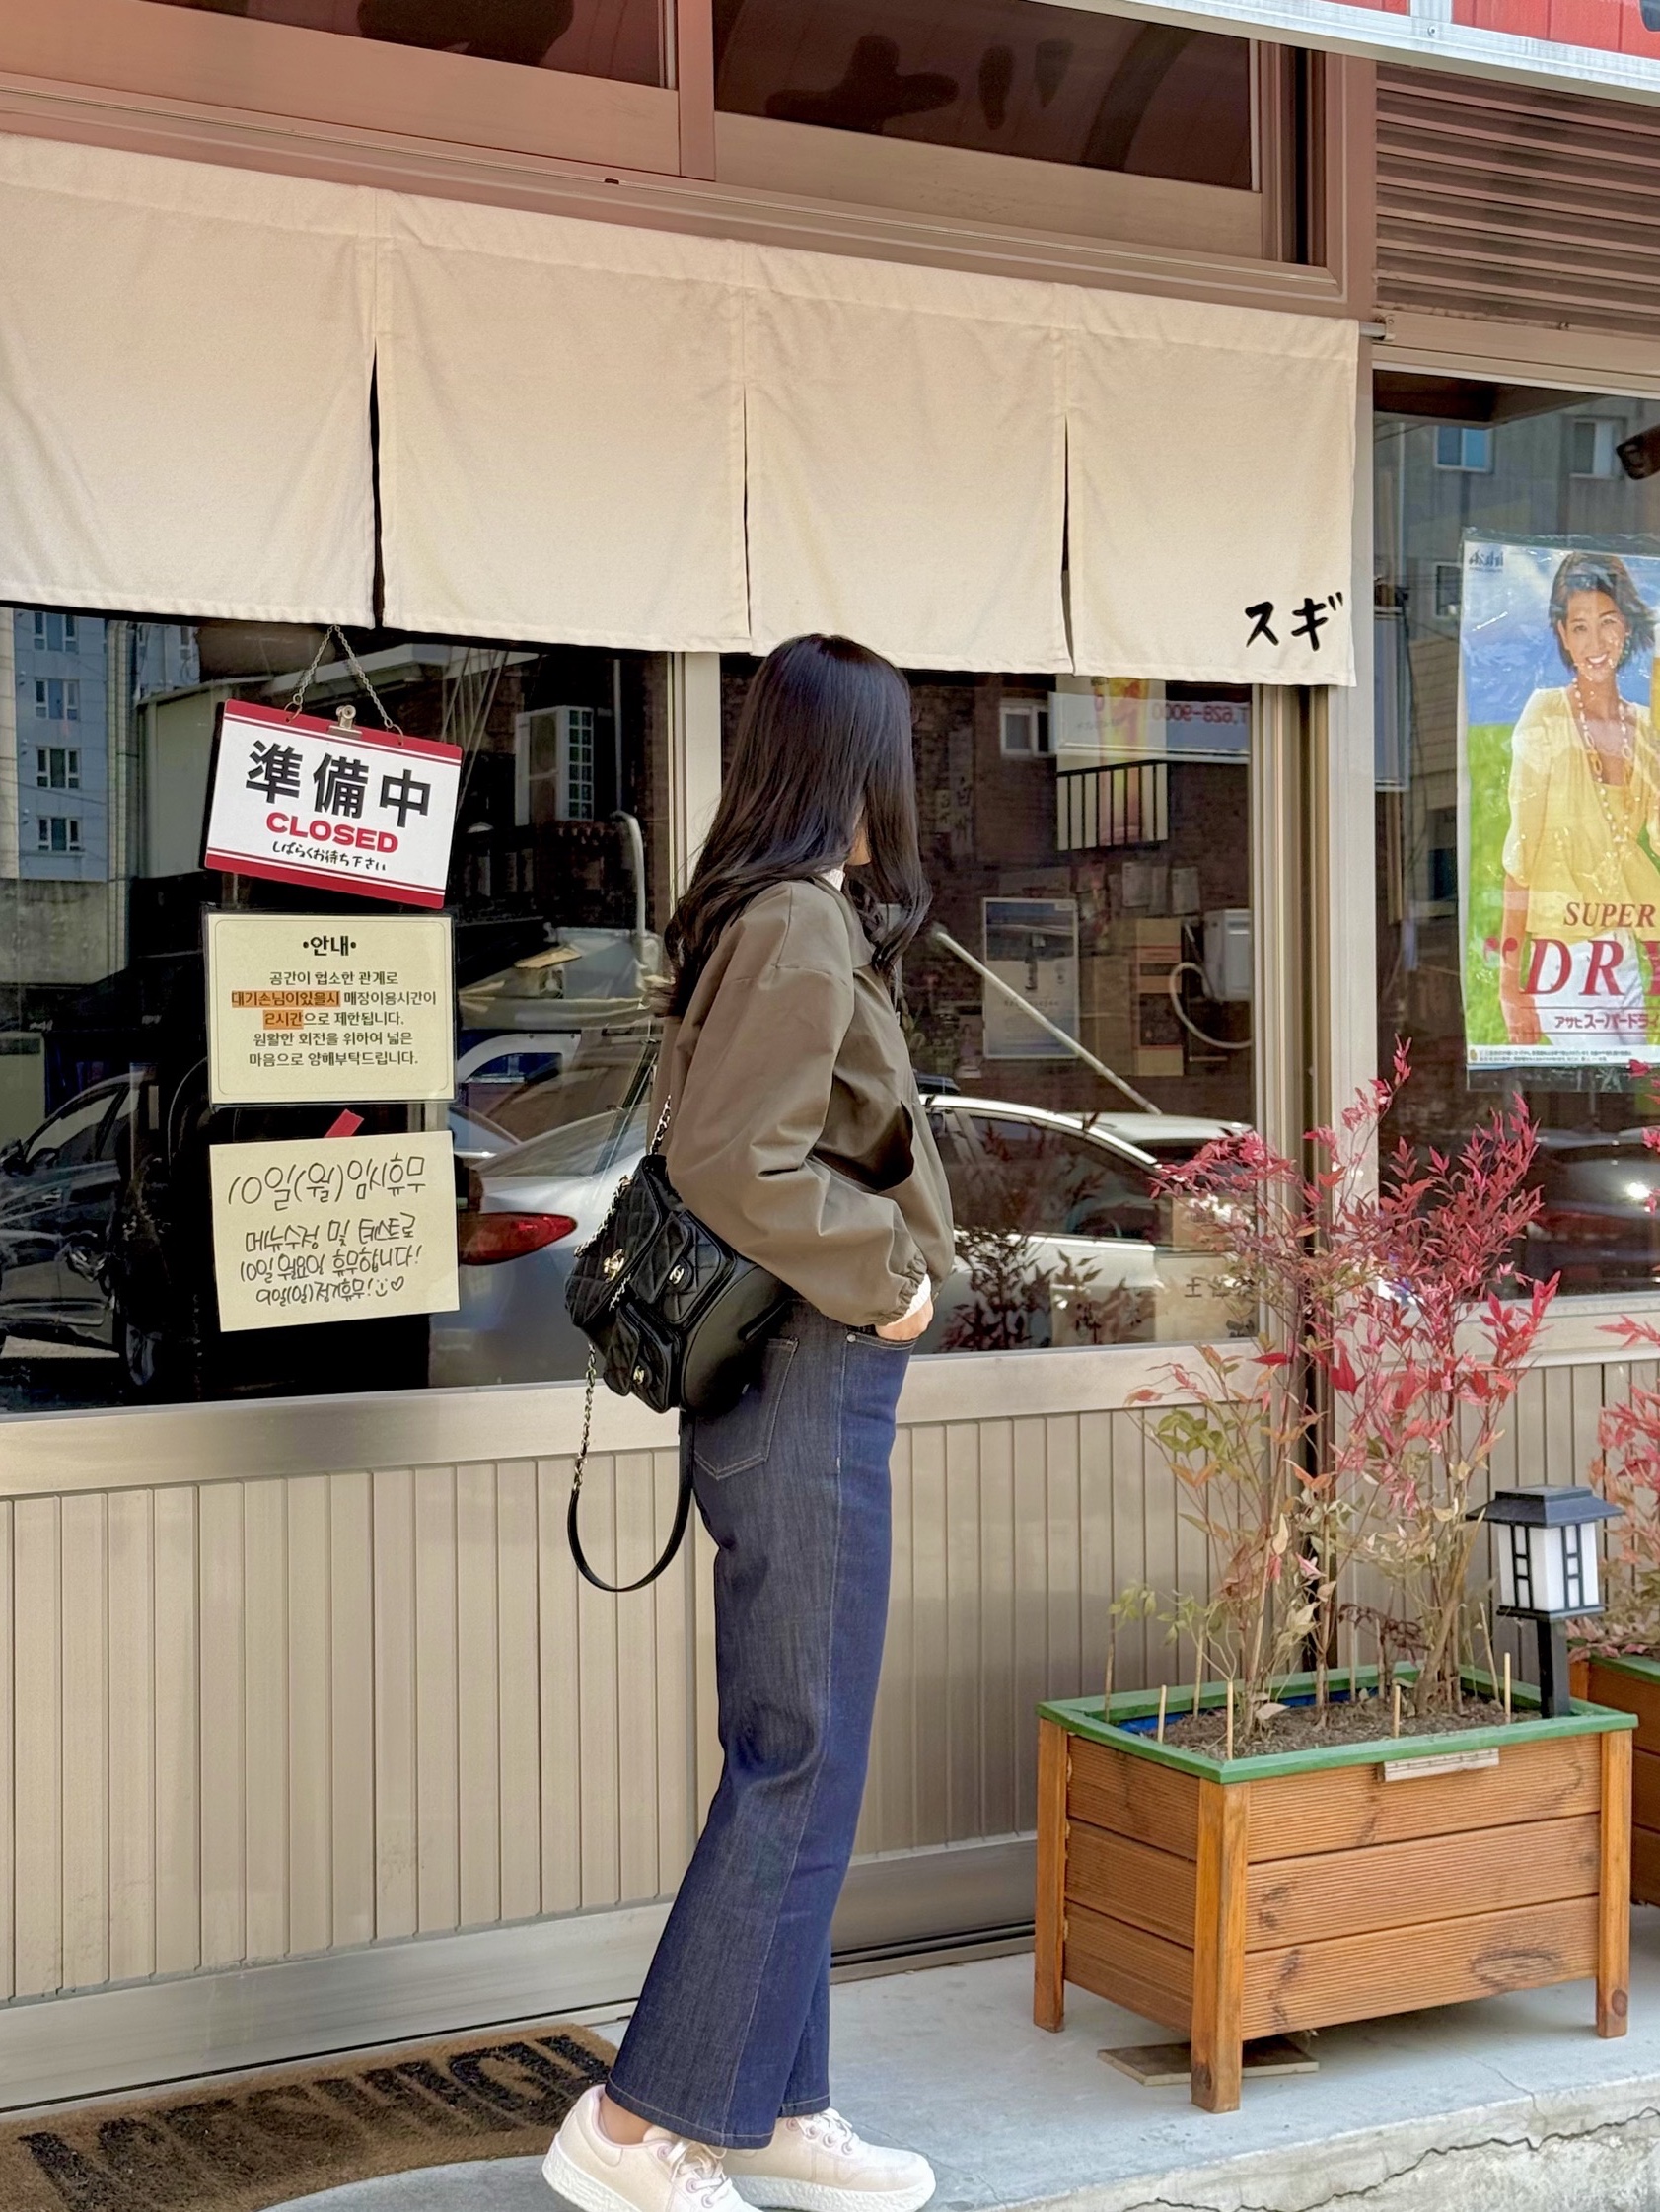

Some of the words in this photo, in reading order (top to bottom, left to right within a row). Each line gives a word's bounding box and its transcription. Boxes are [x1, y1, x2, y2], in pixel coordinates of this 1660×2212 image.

[1245, 591, 1343, 652] スギ
[245, 739, 432, 828] 準備中
[265, 811, 398, 854] CLOSED
[272, 840, 387, 871] しばらくお待ち下さい
[1563, 901, 1657, 928] SUPER
[269, 971, 311, 985] 공간이
[315, 971, 354, 985] 협소한
[358, 971, 399, 985] 관계로
[232, 991, 340, 1007] 대기손님이있을시
[343, 991, 436, 1006] 매장이용시간이
[265, 1012, 330, 1026] 2시간으로
[333, 1011, 405, 1026] 제한됩니다.
[253, 1033, 294, 1047] 원활한
[298, 1033, 339, 1046] 회전을
[342, 1032, 383, 1046] 위하여
[387, 1032, 413, 1045] 넓은
[249, 1052, 304, 1067] 마음으로
[308, 1051, 419, 1067] 양해부탁드립니다.
[327, 1219, 350, 1247] 및
[358, 1211, 416, 1244] 테스트로
[331, 1244, 423, 1277] 휴무합니다!
